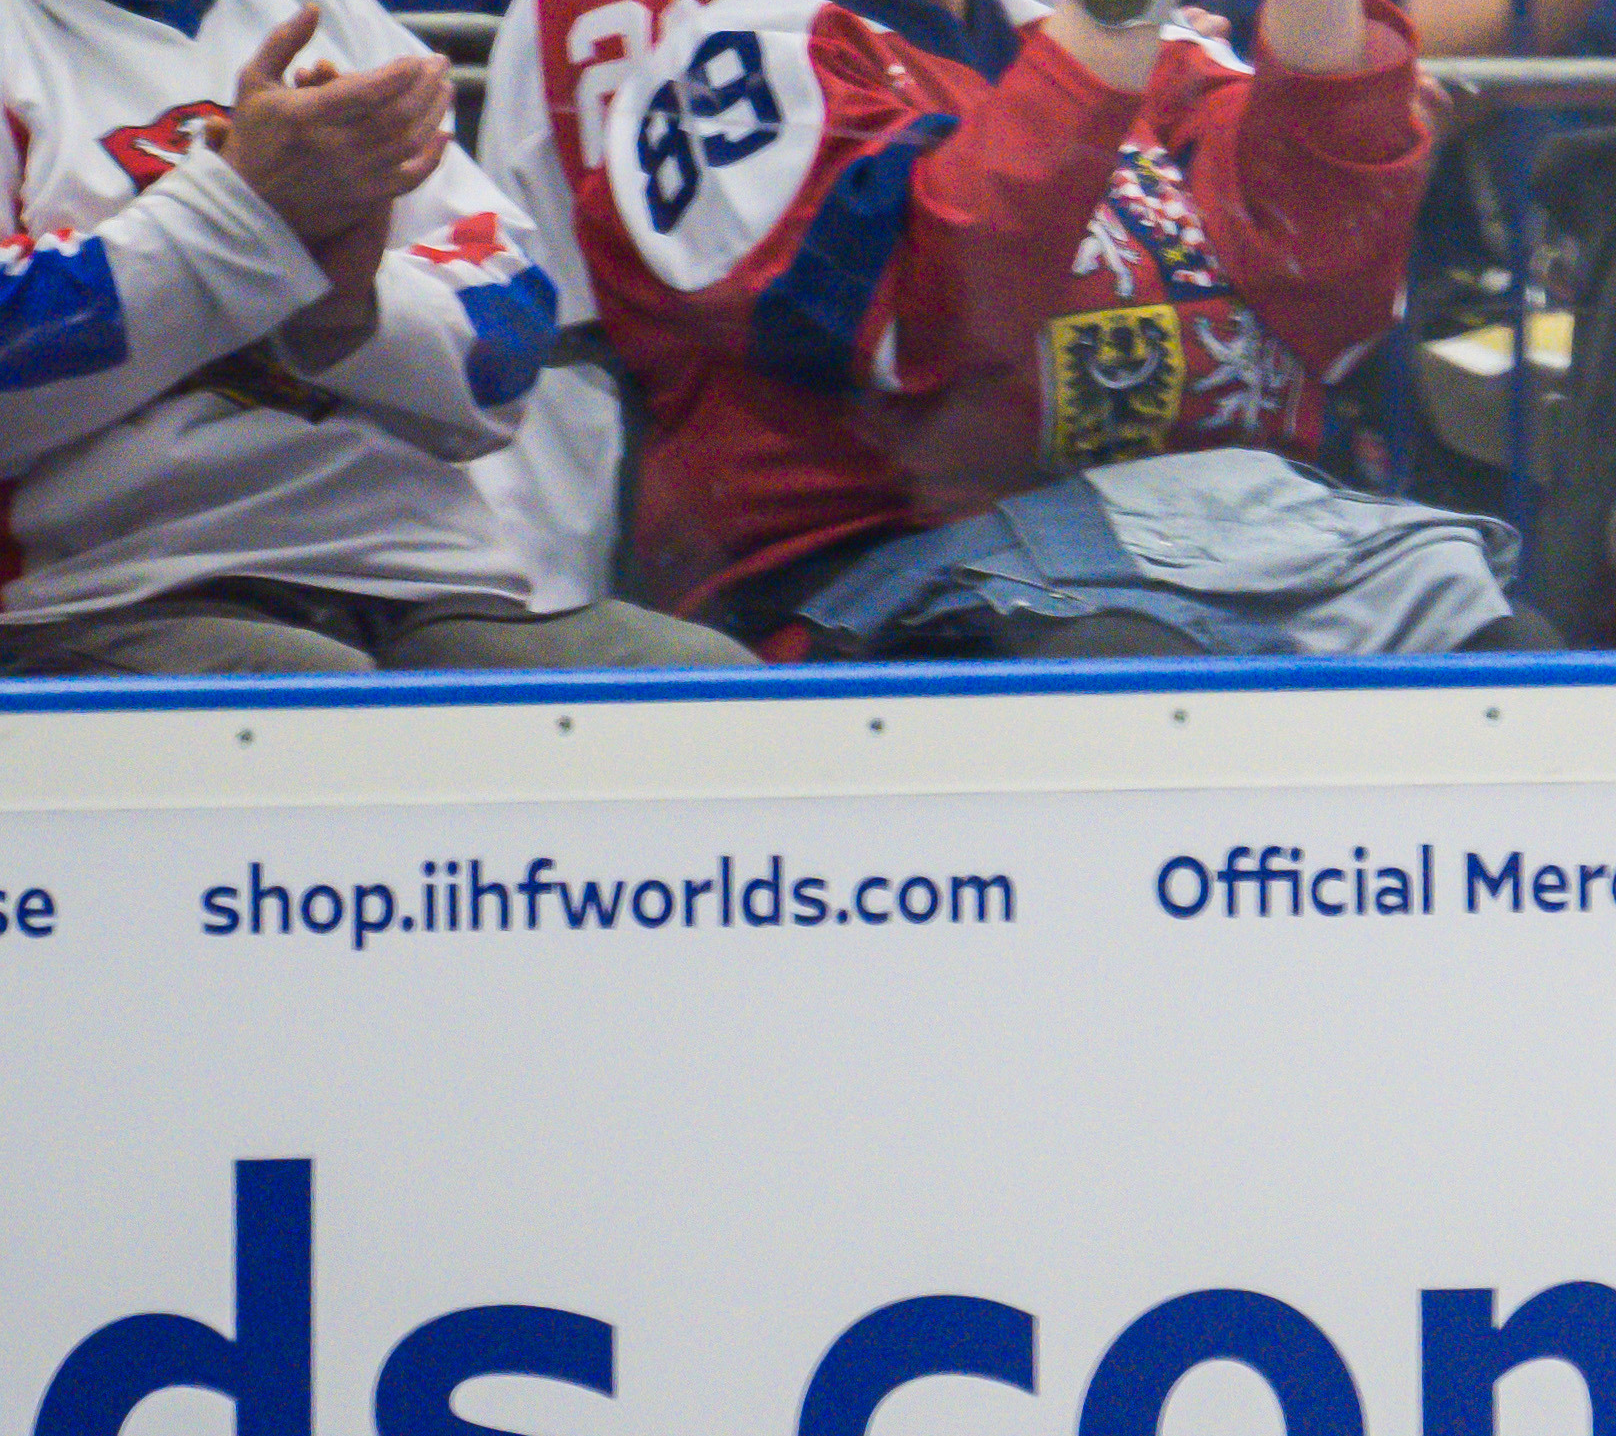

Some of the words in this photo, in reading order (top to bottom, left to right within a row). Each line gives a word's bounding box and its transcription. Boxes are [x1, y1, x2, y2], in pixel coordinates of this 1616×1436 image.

[637, 30, 783, 235] 89
[201, 856, 1014, 951] shop.iihfworlds.com
[1155, 843, 1434, 918] Official
